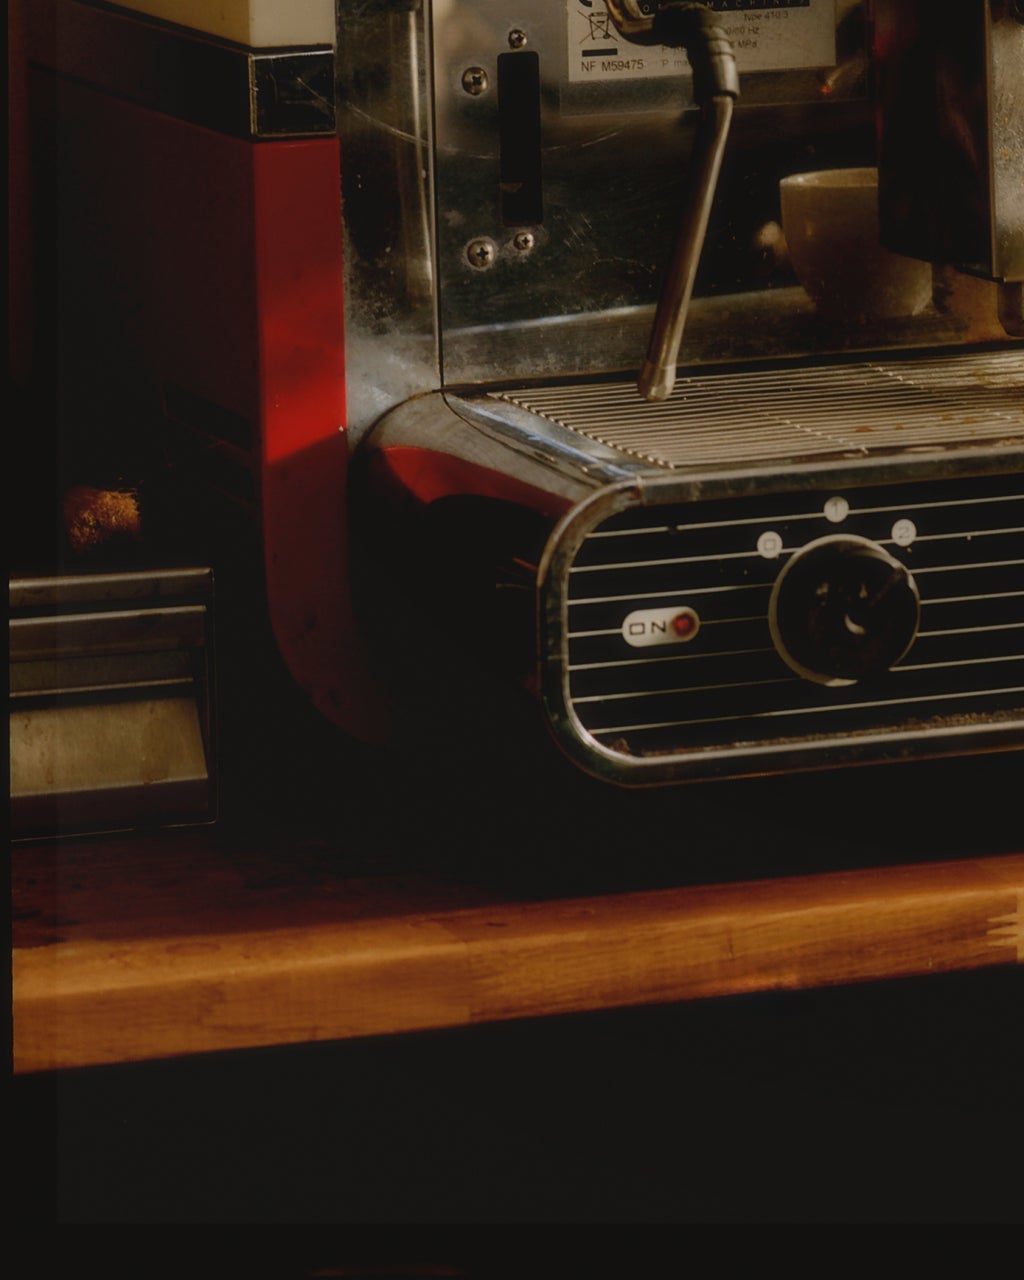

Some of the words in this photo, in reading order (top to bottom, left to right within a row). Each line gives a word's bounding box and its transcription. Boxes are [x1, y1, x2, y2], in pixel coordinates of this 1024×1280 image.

[580, 60, 596, 72] NF
[601, 59, 644, 72] M59475
[898, 526, 910, 539] 2
[629, 619, 667, 635] ON
